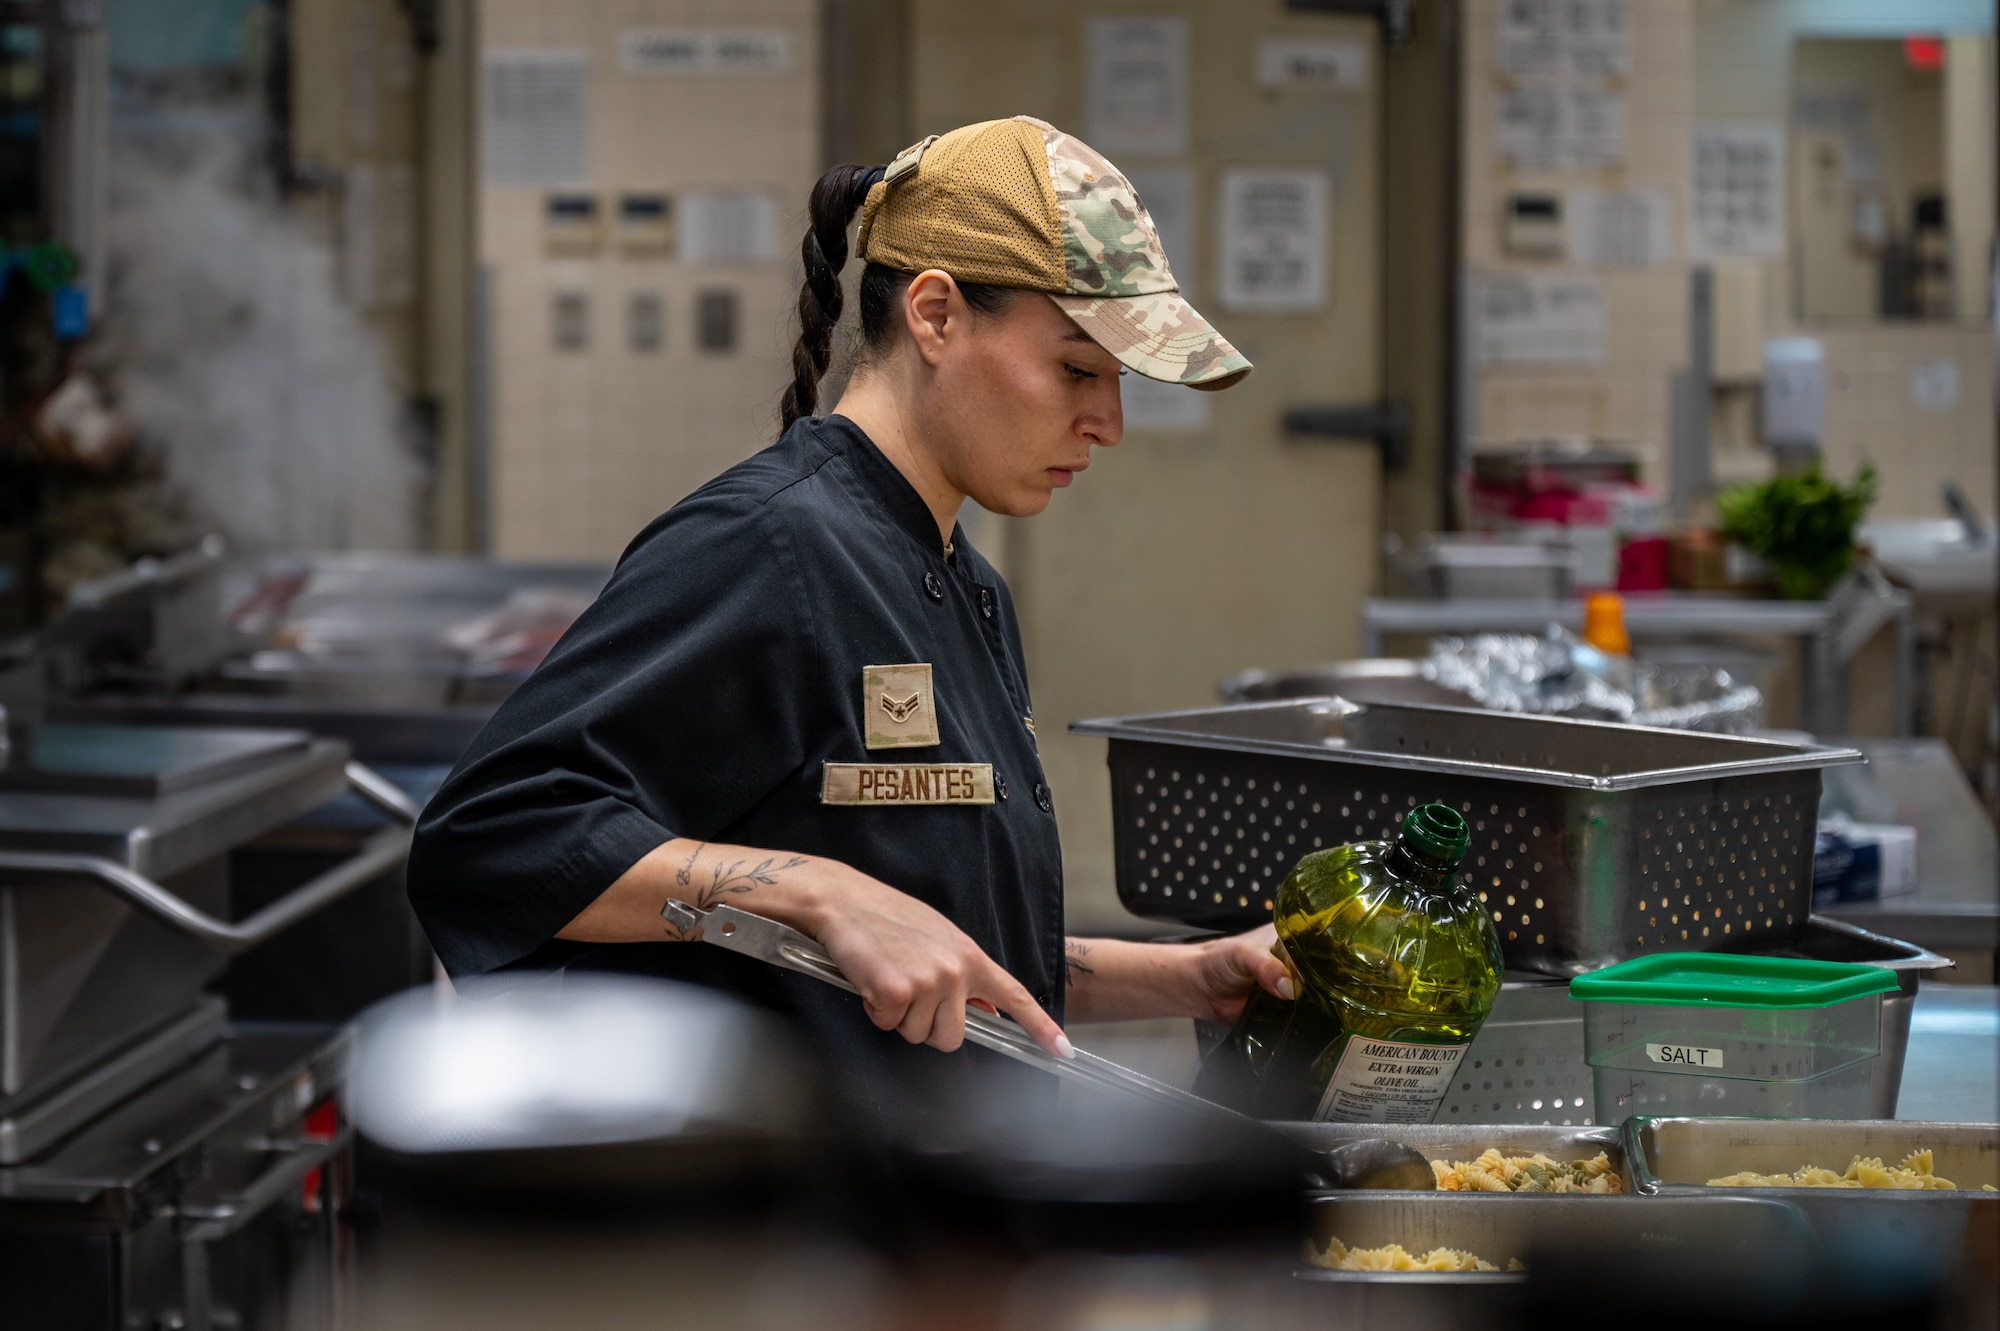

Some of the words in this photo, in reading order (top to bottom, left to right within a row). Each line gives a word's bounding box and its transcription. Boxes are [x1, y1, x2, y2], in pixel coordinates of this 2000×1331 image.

[858, 768, 975, 801] PESANTES
[1360, 1043, 1420, 1060] AMERICAN
[1419, 1048, 1458, 1061] BOUNTY
[1660, 1046, 1709, 1065] SALT
[1368, 1062, 1403, 1075] EXTRA
[1405, 1065, 1442, 1076] VIRGIN
[1374, 1076, 1404, 1087] OLIVE
[1403, 1078, 1420, 1088] OIL
